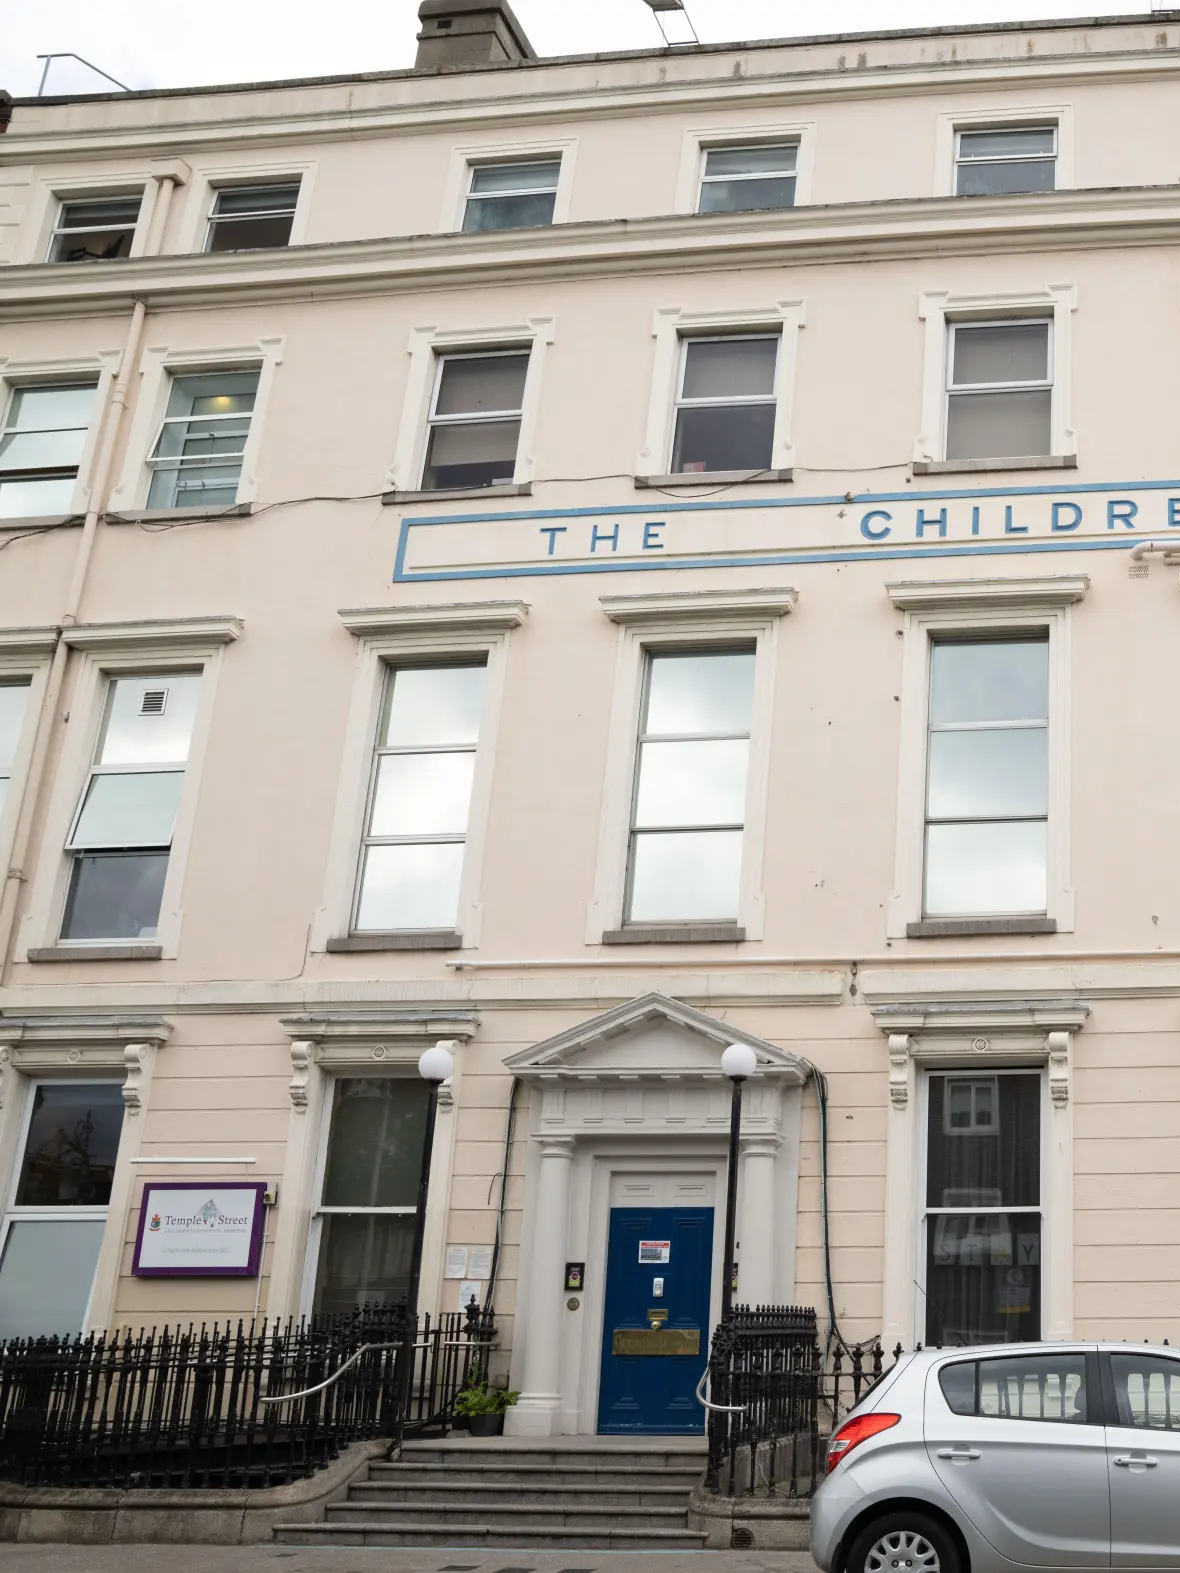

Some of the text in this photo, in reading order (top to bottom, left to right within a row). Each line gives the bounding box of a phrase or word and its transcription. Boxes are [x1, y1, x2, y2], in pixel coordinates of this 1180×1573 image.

[540, 521, 667, 556] THE
[164, 1214, 249, 1228] Temple Street
[940, 1243, 1034, 1262] STY
